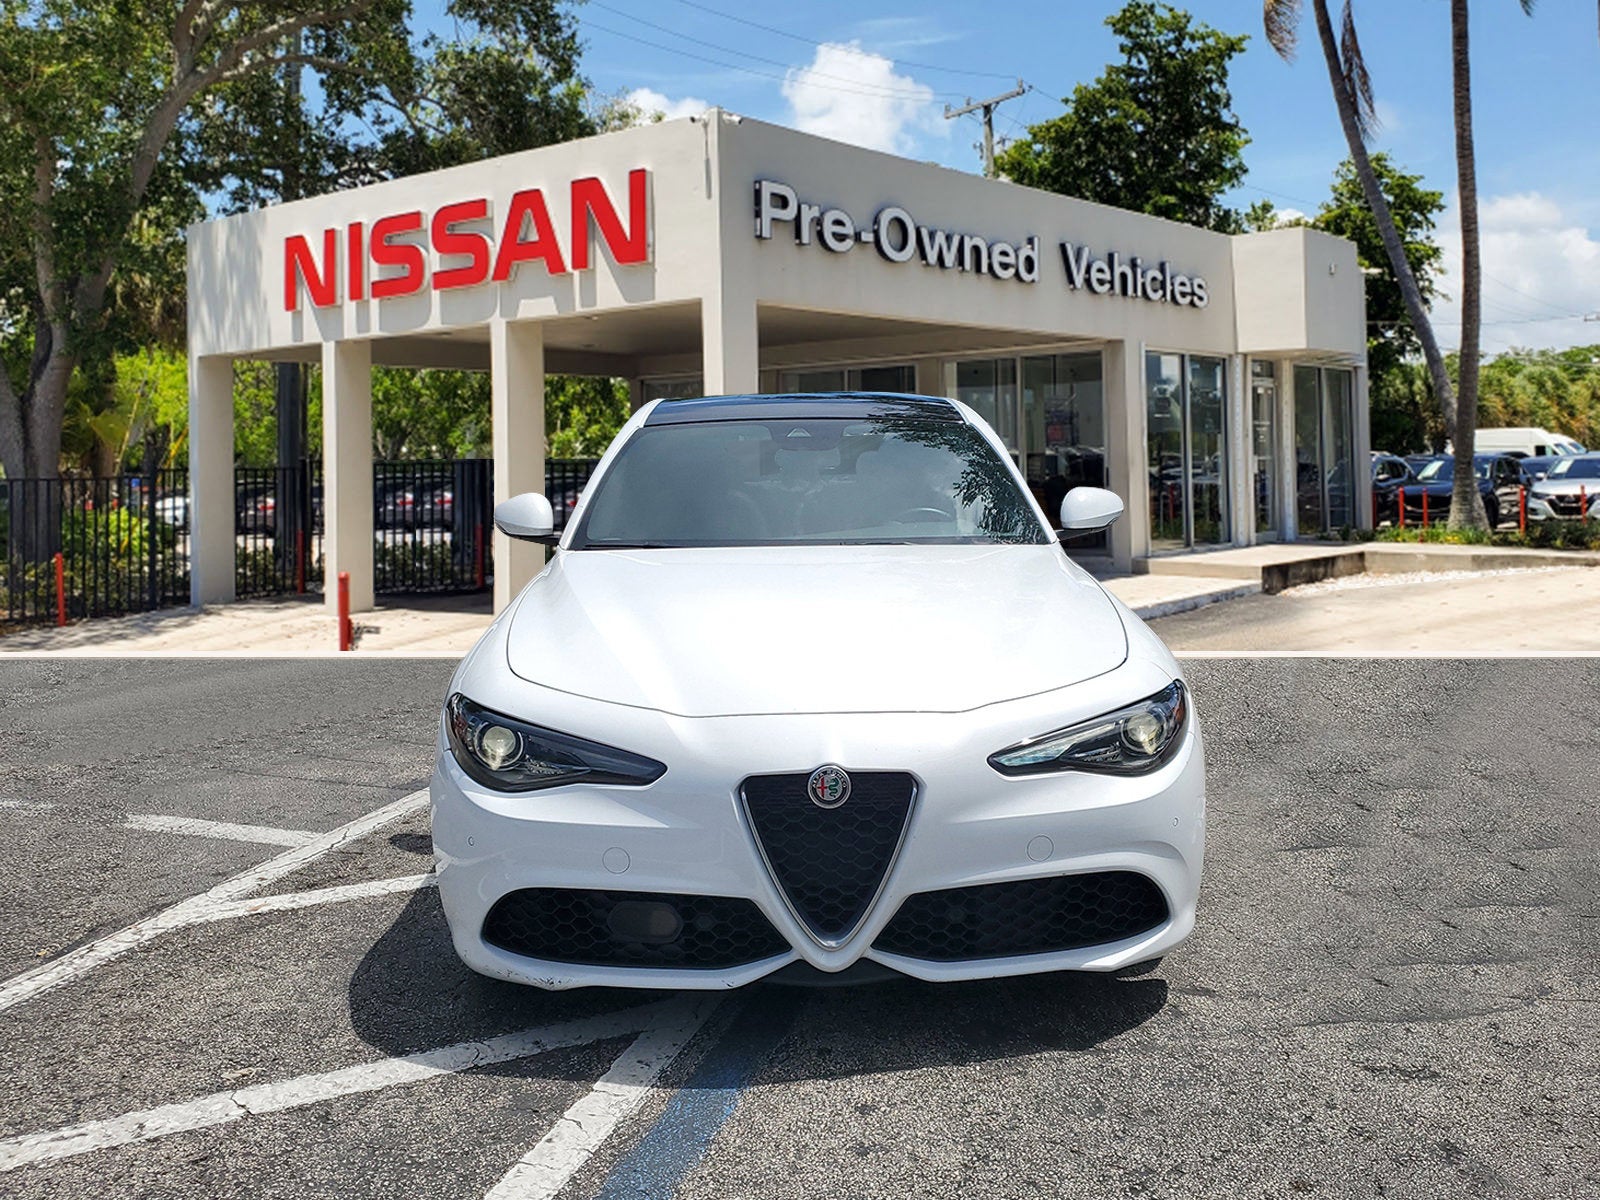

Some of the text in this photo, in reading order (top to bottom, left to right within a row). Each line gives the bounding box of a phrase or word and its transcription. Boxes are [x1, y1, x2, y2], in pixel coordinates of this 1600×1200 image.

[285, 168, 648, 312] NISSAN
[754, 179, 1209, 308] Pre-Owned Vehicles
